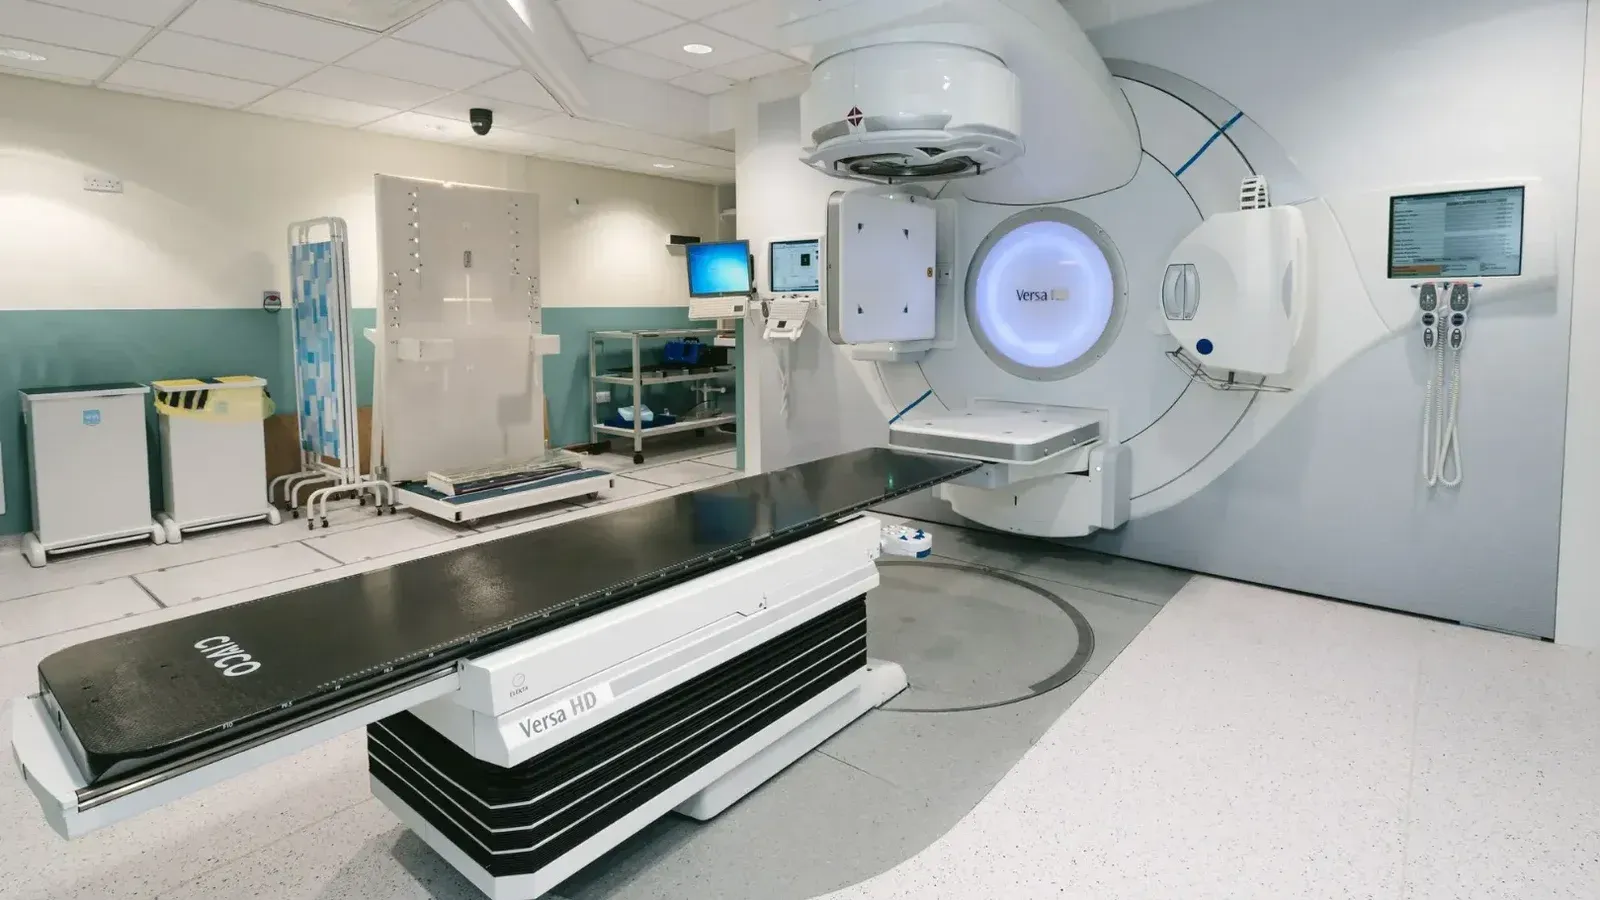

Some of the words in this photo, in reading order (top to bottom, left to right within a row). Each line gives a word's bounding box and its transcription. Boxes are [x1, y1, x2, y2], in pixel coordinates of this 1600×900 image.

[1016, 289, 1048, 301] Versa
[194, 636, 262, 677] CIVCO
[519, 708, 567, 738] Versa
[569, 691, 597, 716] HD
